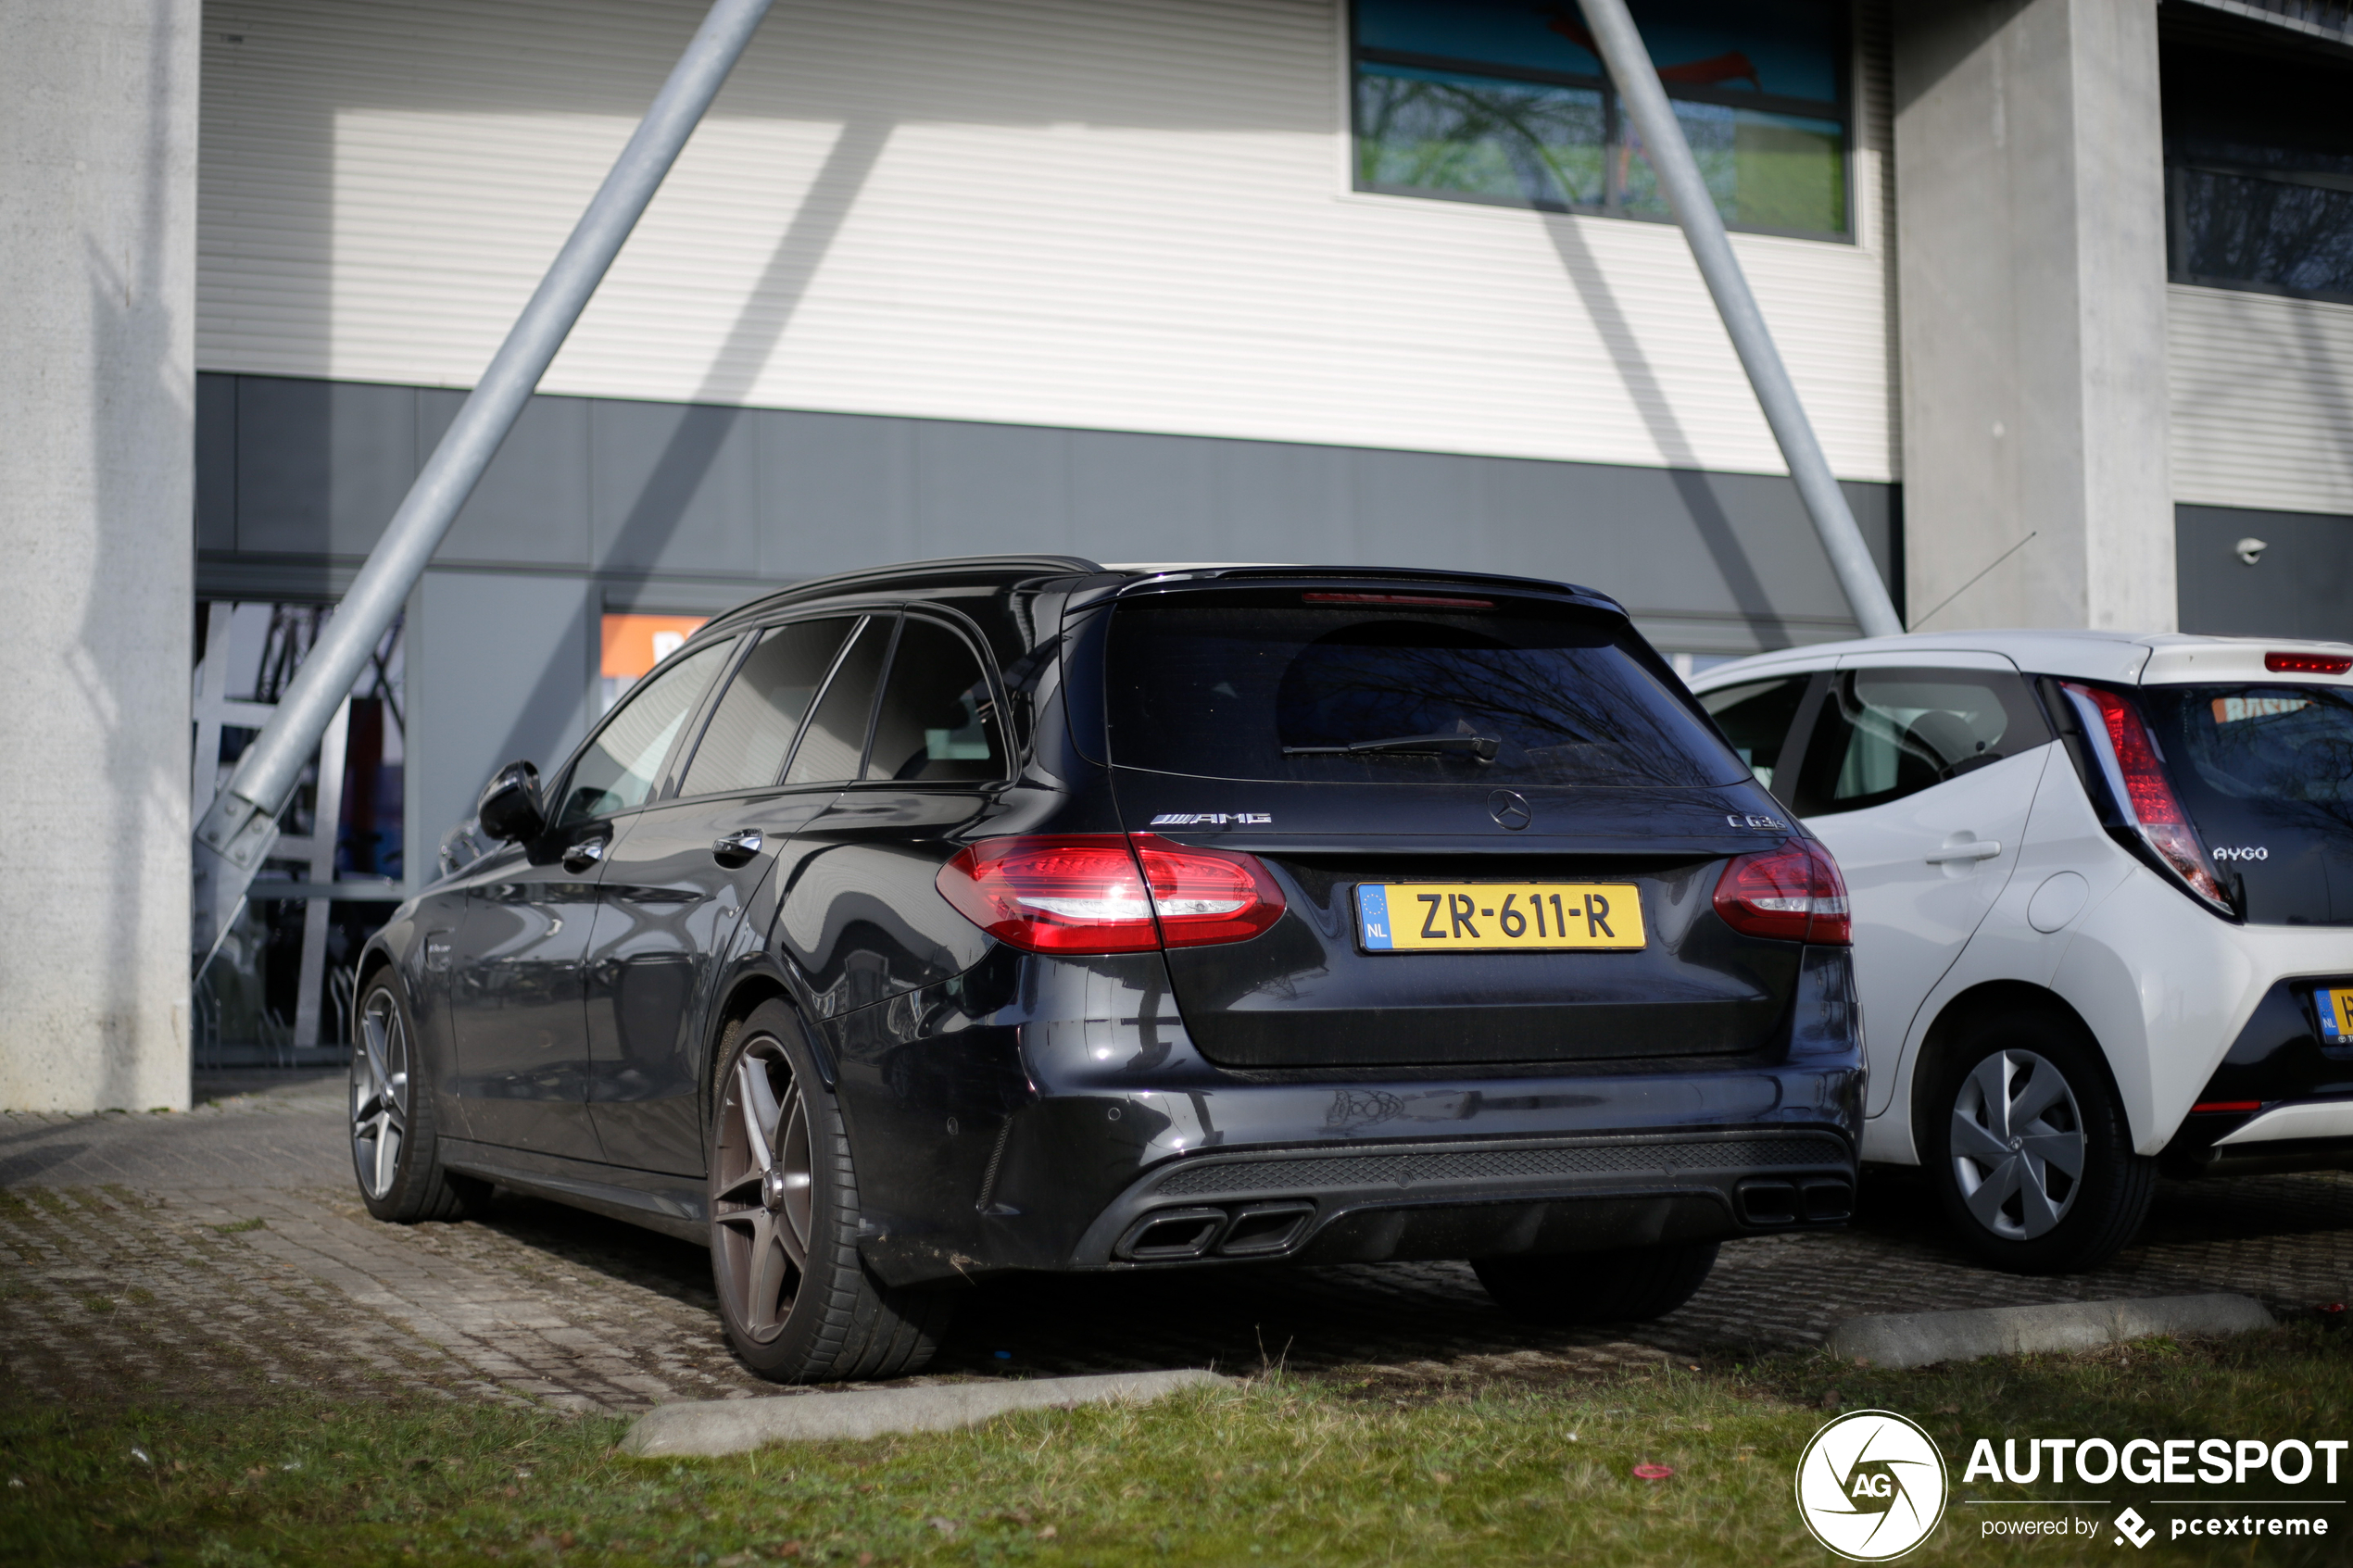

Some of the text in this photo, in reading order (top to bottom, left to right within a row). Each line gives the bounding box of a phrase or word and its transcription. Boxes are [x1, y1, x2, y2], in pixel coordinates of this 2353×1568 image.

[1727, 815, 1743, 827] C
[2213, 847, 2268, 861] AYGO
[1416, 894, 1615, 938] ZR-611-R
[1366, 923, 1388, 937] NL
[2322, 1018, 2336, 1028] NL
